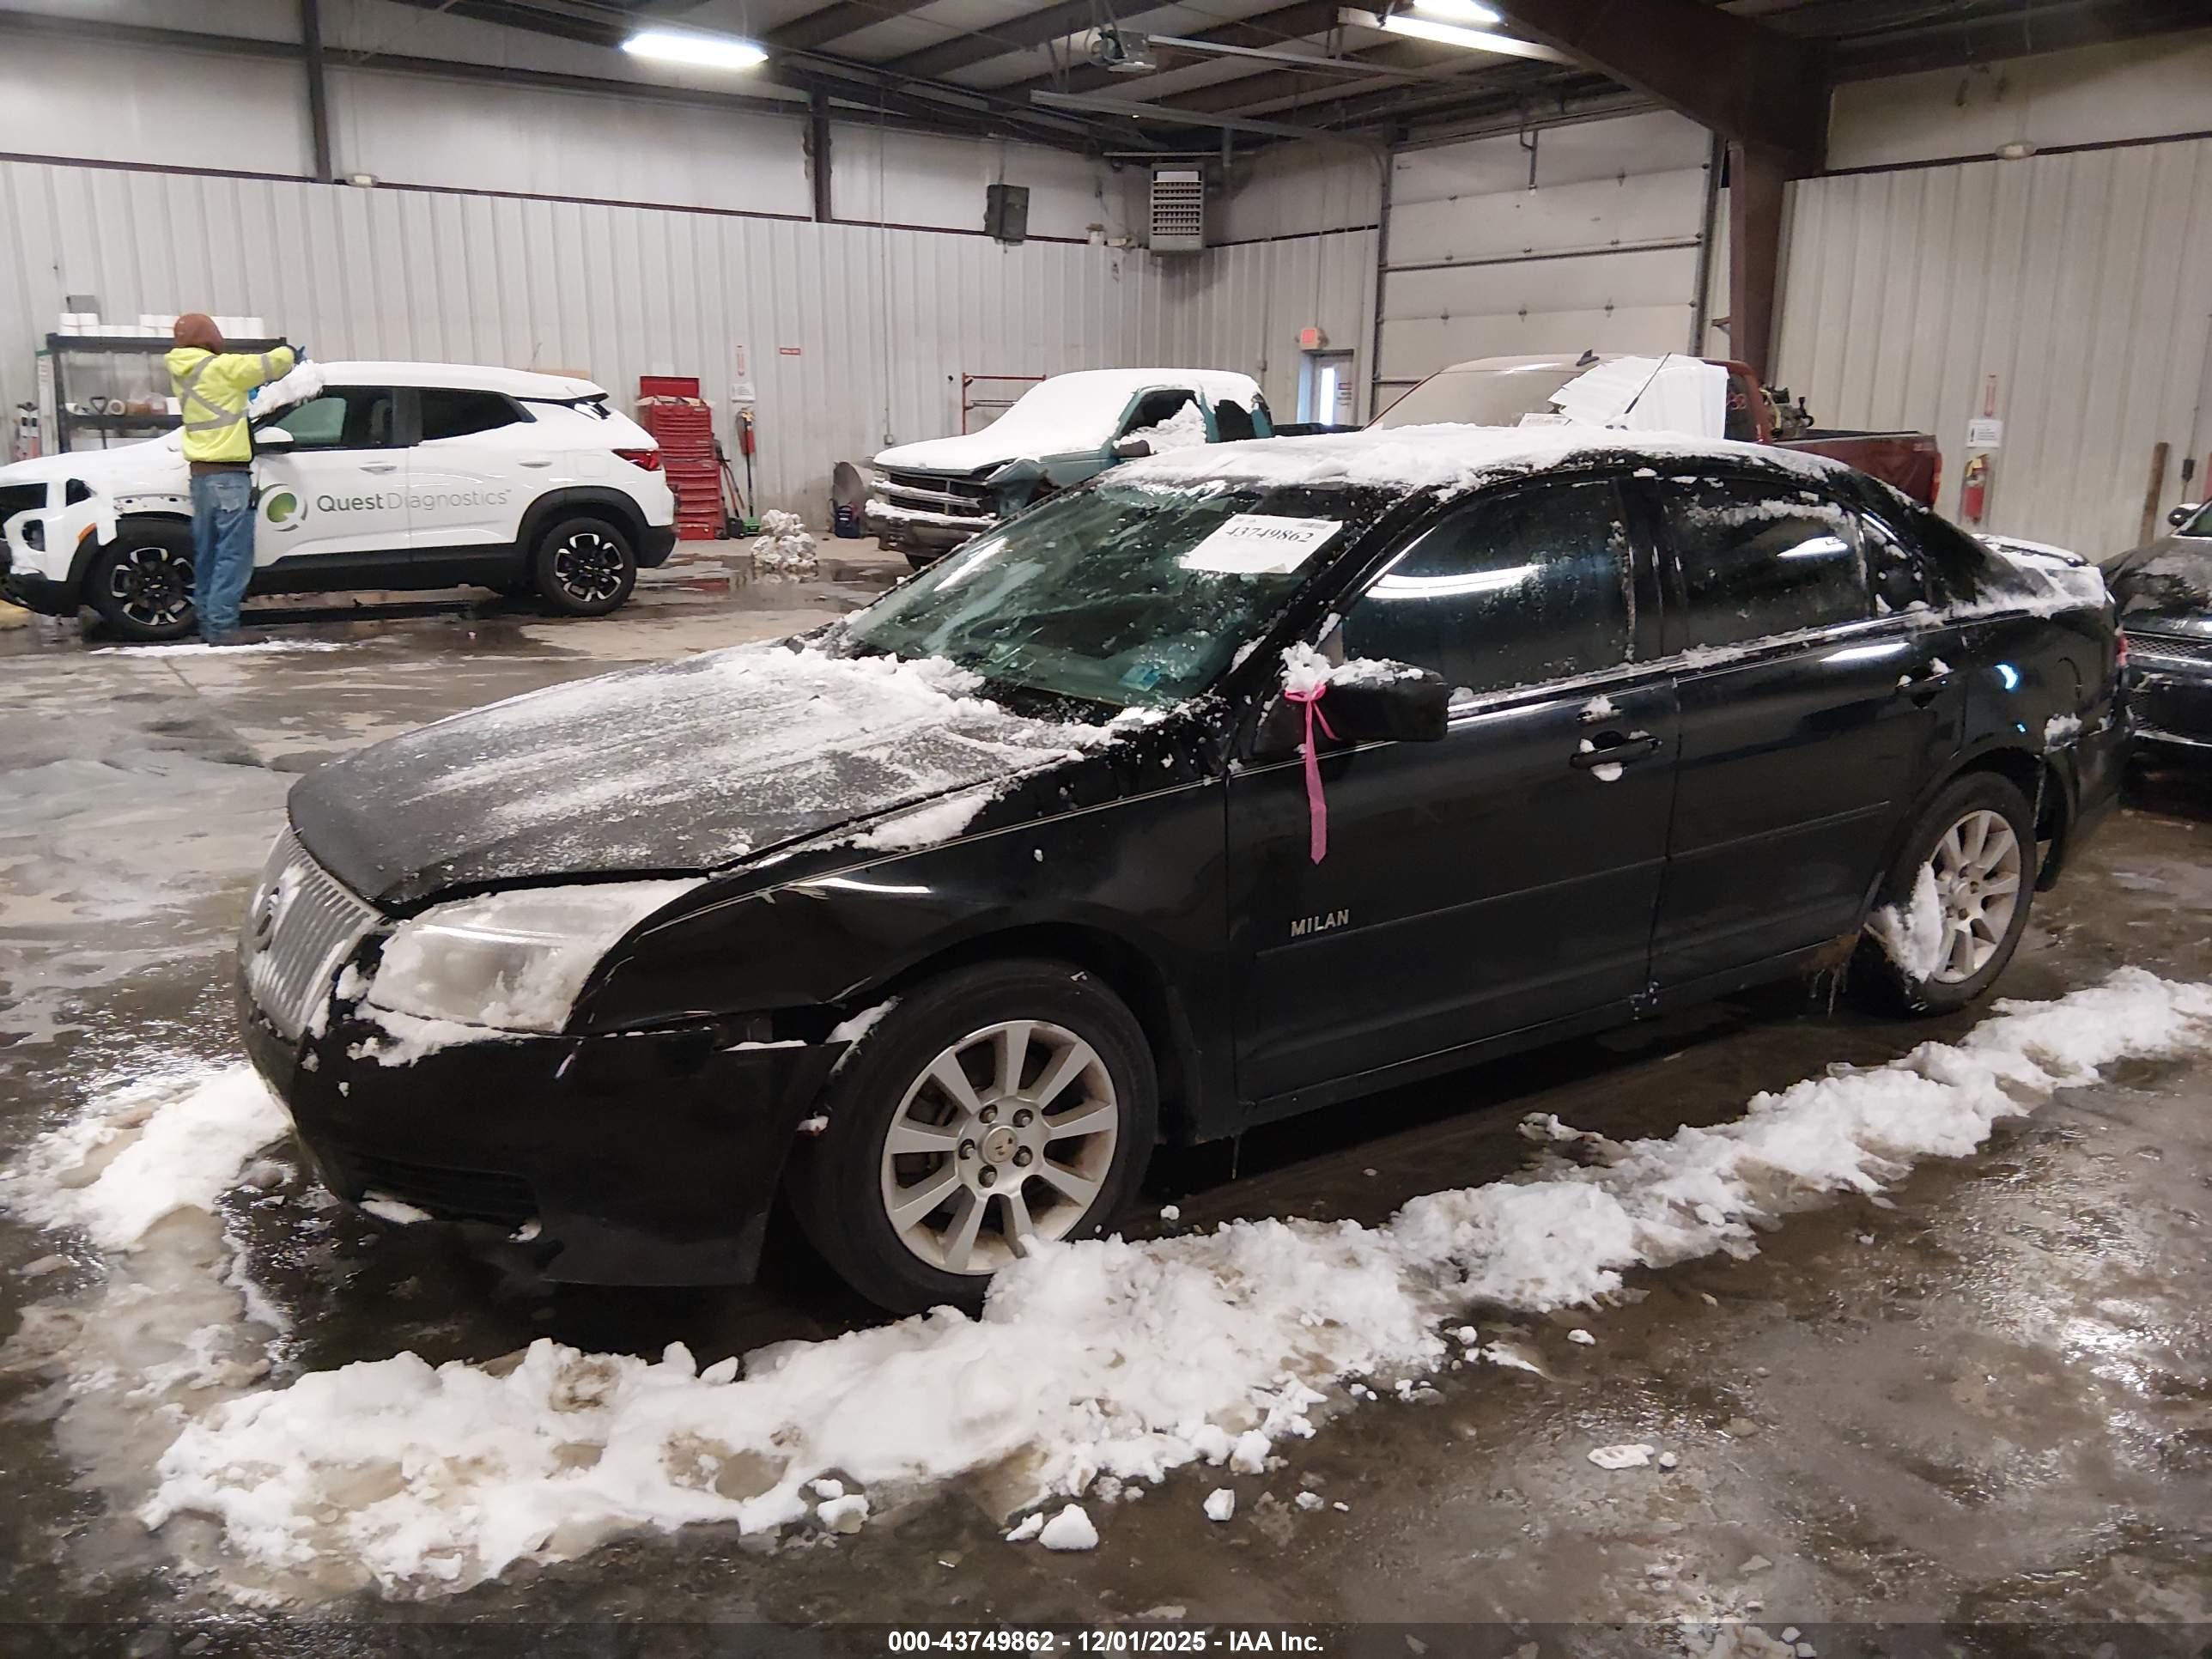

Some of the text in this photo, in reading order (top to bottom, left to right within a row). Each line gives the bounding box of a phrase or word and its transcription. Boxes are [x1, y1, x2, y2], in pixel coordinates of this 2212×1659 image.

[317, 489, 507, 512] Quest Diagnostics
[1226, 526, 1314, 543] 43749862
[1291, 908, 1350, 938] MILAN
